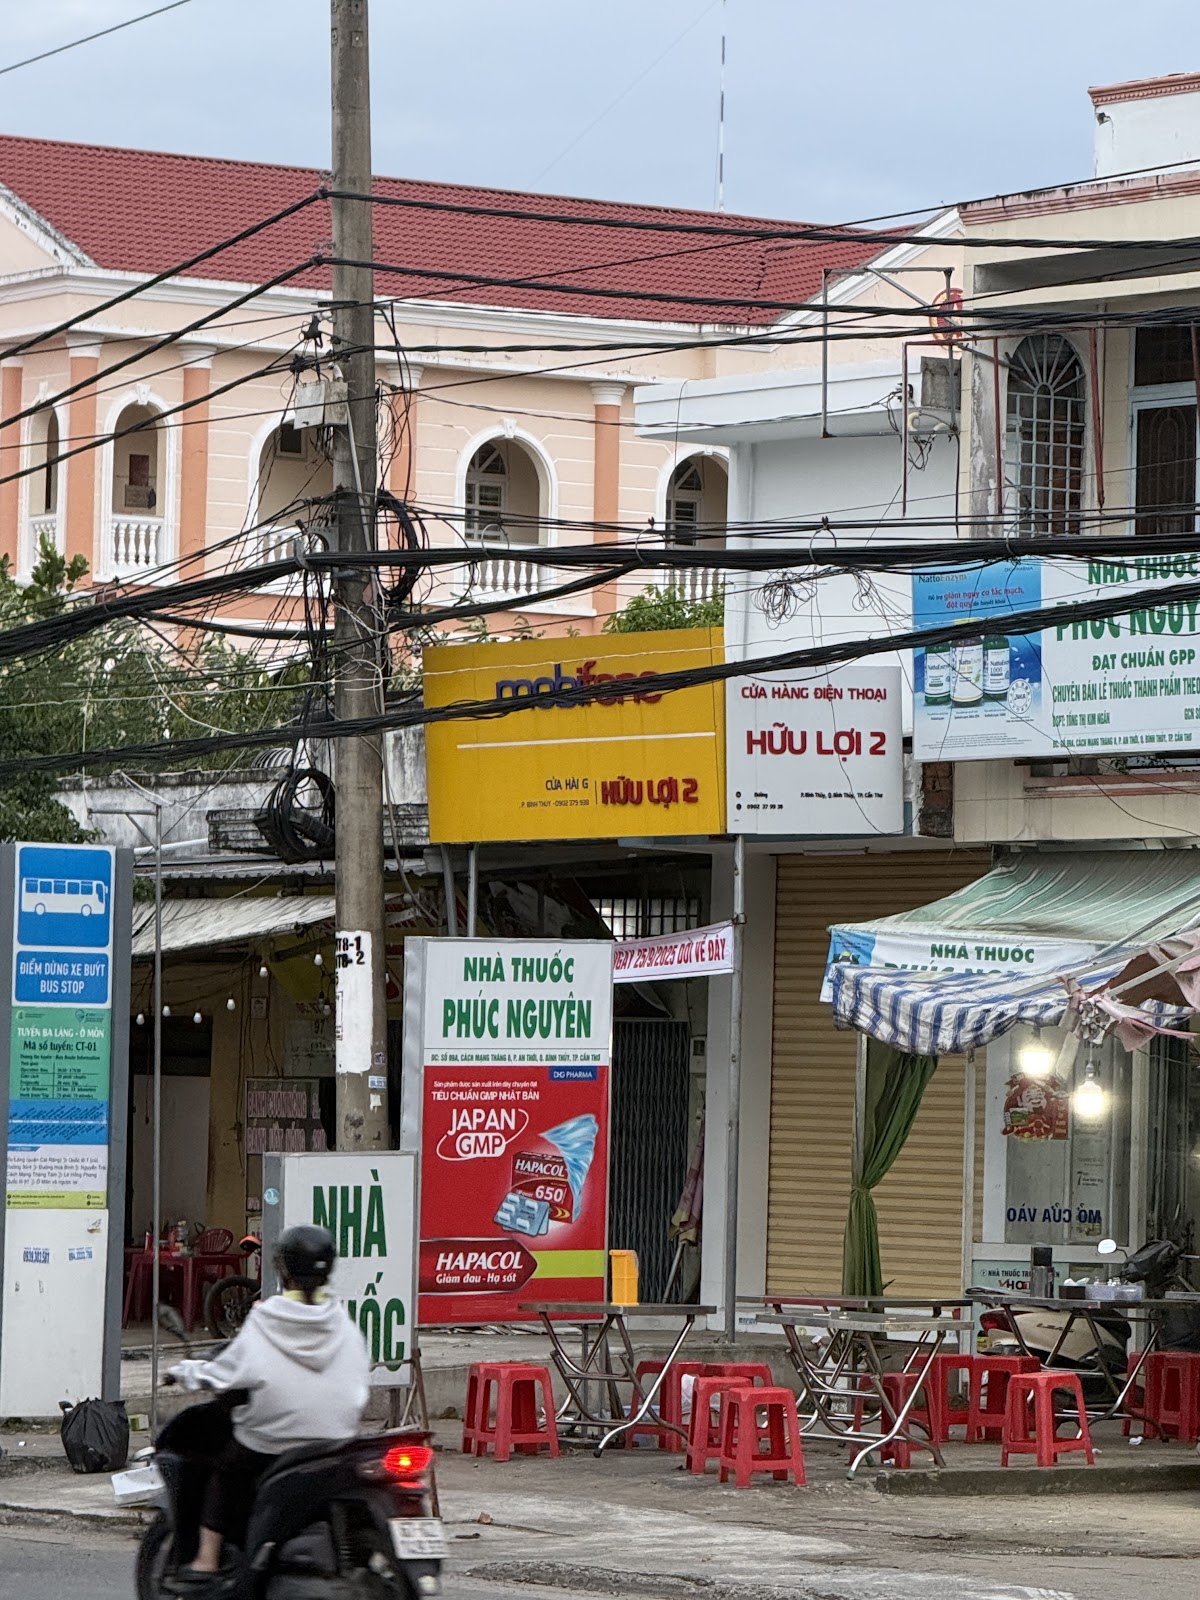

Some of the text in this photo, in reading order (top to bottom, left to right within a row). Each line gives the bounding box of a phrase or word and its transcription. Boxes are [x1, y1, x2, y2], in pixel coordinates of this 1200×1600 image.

[918, 574, 966, 584] NattoEnzym
[1092, 645, 1195, 674] ĐẠT CHUẨN GPP
[741, 683, 887, 702] CỬA HÀNG ĐIỆN THOẠI
[1109, 675, 1132, 699] THUỐC
[1134, 676, 1157, 698] THÀNH
[747, 722, 807, 755] HỮU
[816, 728, 861, 762] LỢI
[869, 731, 886, 755] 2
[601, 775, 698, 809] HỮU LỢI 2
[633, 945, 678, 969] 25/9/2025
[930, 942, 1035, 963] NHÀ THUỐC
[20, 958, 105, 977] ĐIỂM DỪNG XE BUÝT
[464, 949, 574, 983] NHÀ THUỐC
[40, 981, 84, 994] BUS STOP
[443, 990, 592, 1039] PHÚC NGUYÊN
[76, 1042, 96, 1051] CT-01
[460, 1053, 473, 1062] CÁCH
[475, 1054, 489, 1062] MẠNG
[491, 1053, 506, 1062] THÁNG
[566, 1070, 593, 1078] PHARMA
[432, 1089, 539, 1102] TIÊU CHUẨN GMP NHẬT BẢN
[449, 1108, 516, 1135] JAPAN
[459, 1135, 503, 1155] GMP
[515, 1159, 565, 1177] HAPACOL
[535, 1185, 563, 1202] 650
[313, 1169, 387, 1257] NHÀ
[436, 1251, 523, 1271] HAPACOL
[436, 1272, 516, 1285] Giảm đau Hạ sốt
